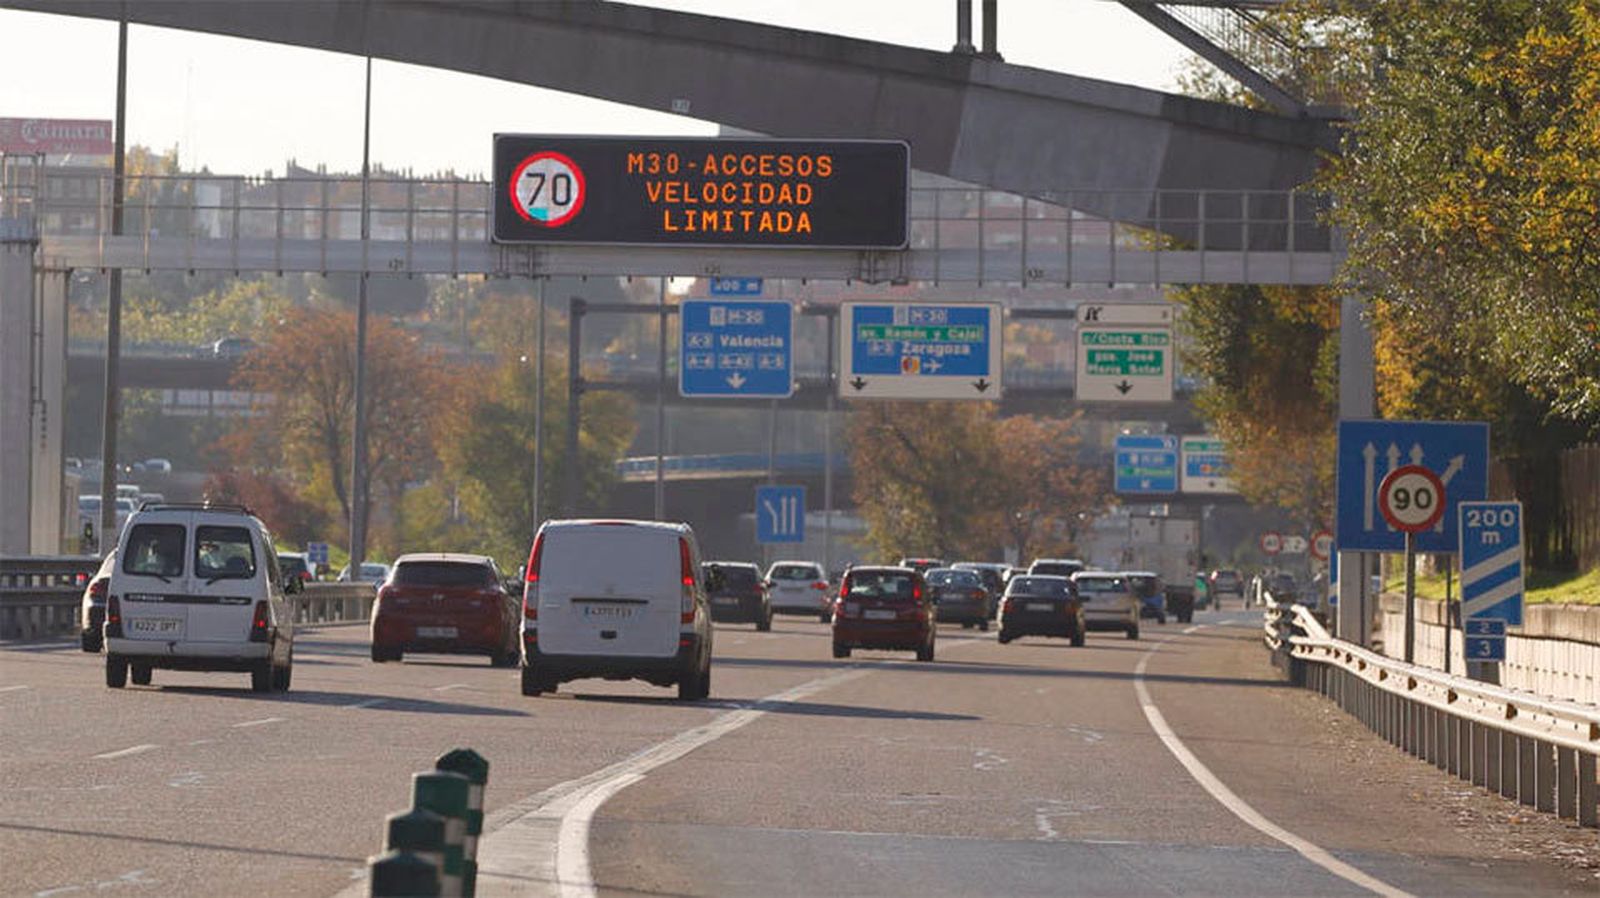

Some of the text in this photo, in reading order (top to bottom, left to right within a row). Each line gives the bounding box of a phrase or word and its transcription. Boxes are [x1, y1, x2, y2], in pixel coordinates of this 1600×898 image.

[627, 153, 833, 177] M30-ACCESOS
[526, 172, 572, 206] 70
[647, 182, 813, 205] VELOCIDAD
[664, 210, 812, 234] LIMITADA
[721, 335, 784, 347] Valencia
[902, 341, 970, 357] Zaragoza
[1394, 488, 1433, 511] 90
[1467, 510, 1515, 527] 200
[1482, 531, 1500, 544] m
[1480, 622, 1490, 634] 2
[1479, 640, 1491, 656] 3
